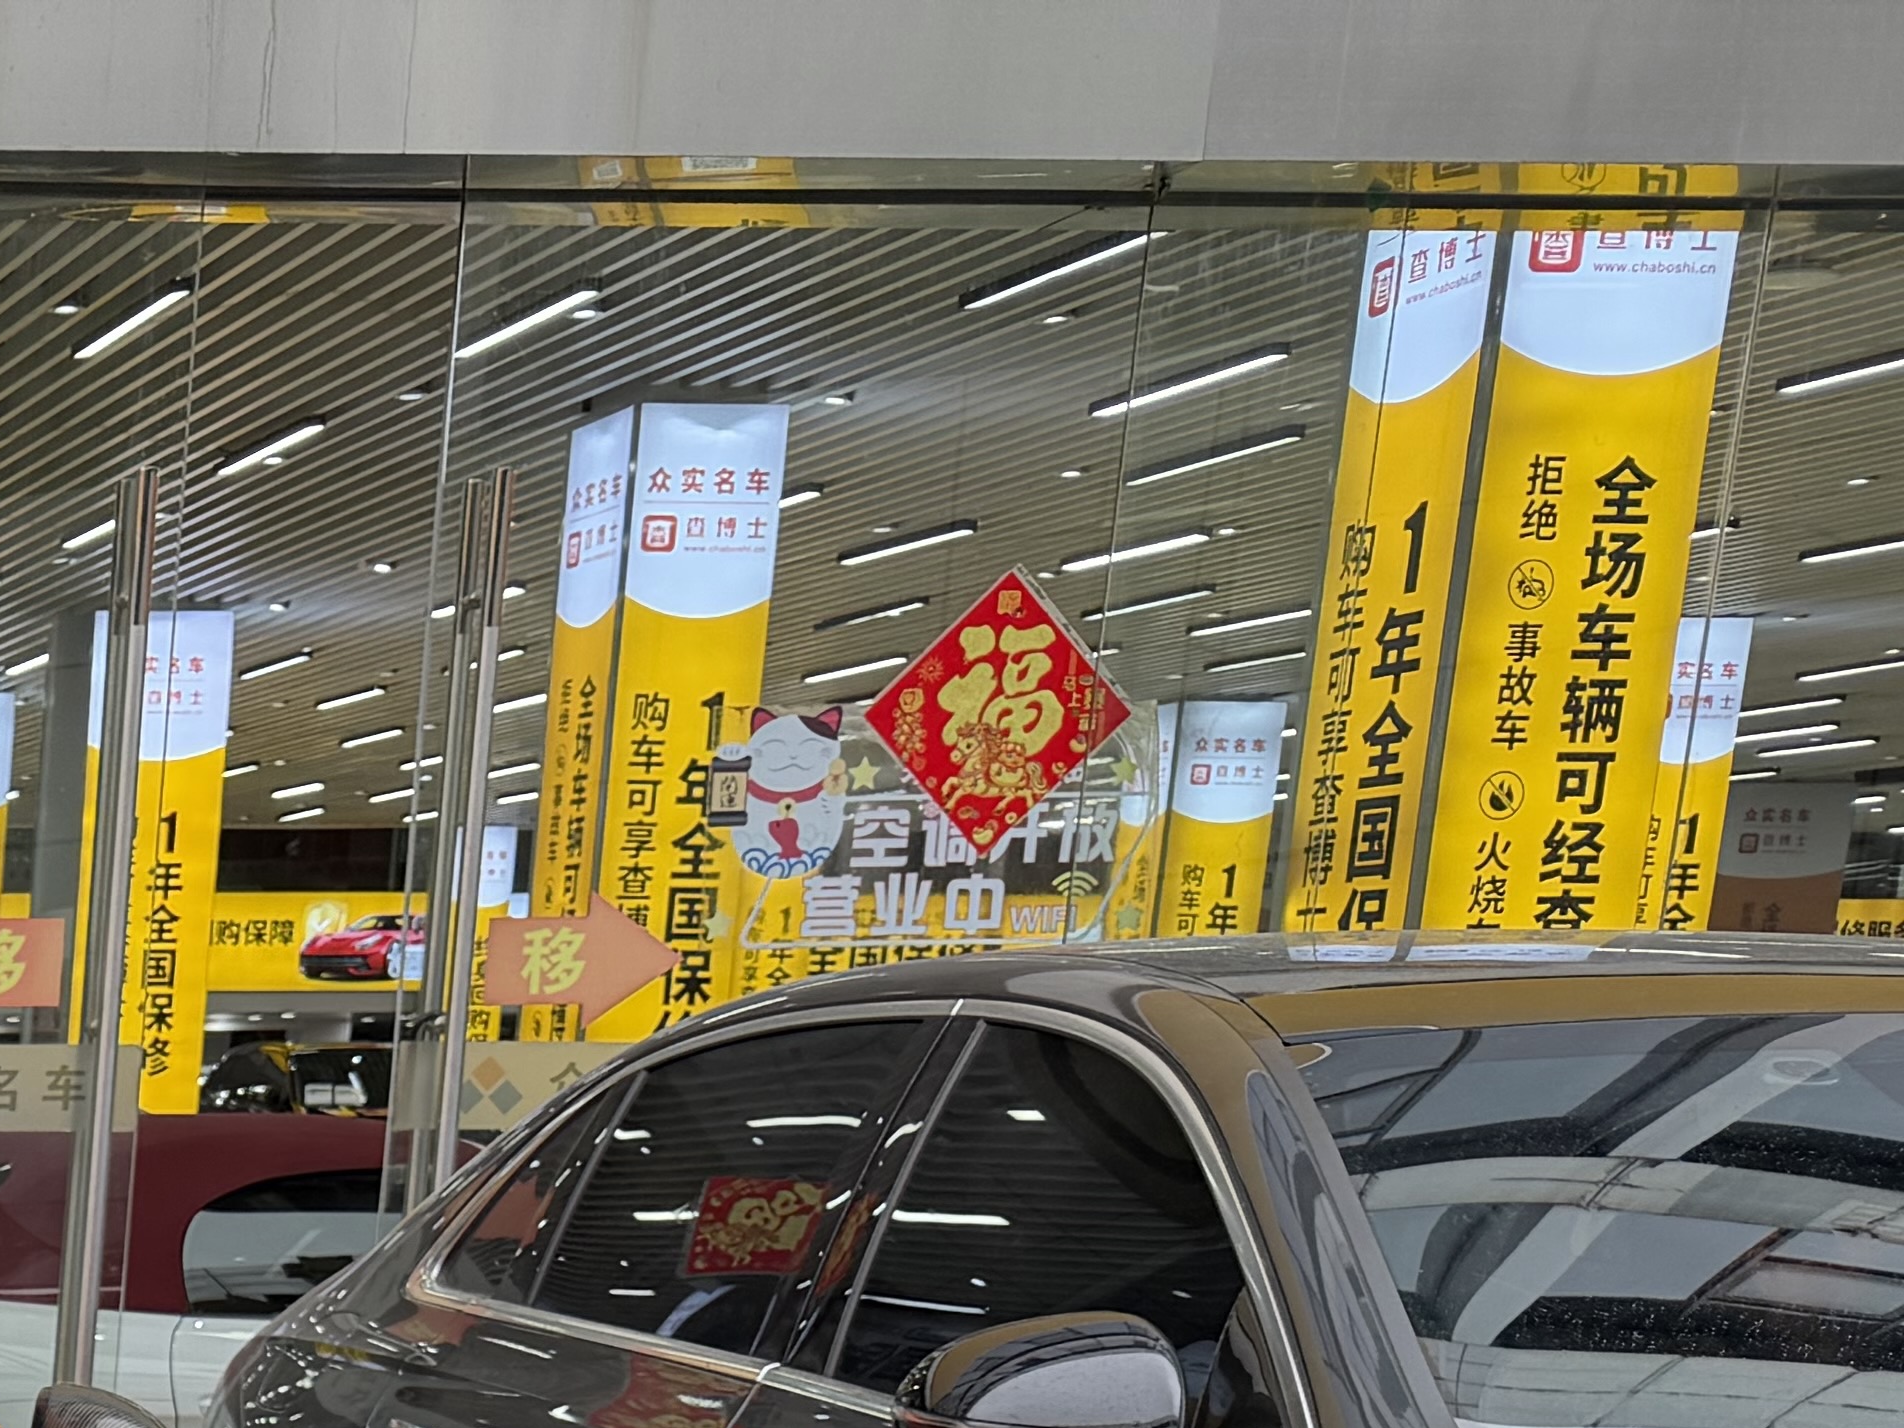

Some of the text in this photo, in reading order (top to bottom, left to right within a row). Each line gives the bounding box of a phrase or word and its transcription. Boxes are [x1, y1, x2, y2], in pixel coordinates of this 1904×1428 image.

[1407, 230, 1486, 285] 查博士
[1593, 260, 1716, 276] www.chaboshi.cn
[647, 466, 771, 496] 众实名车
[1518, 454, 1567, 541] 拒绝
[685, 516, 768, 540] 查博士
[937, 624, 1065, 758] 福
[1491, 621, 1543, 751] 事故车
[1194, 738, 1267, 753] 众实名车
[801, 873, 1077, 937] 营业中 WIFI
[1177, 864, 1205, 936] 购车可
[1206, 863, 1239, 935] 1年
[209, 919, 295, 946] 购保障
[520, 926, 588, 996] 移
